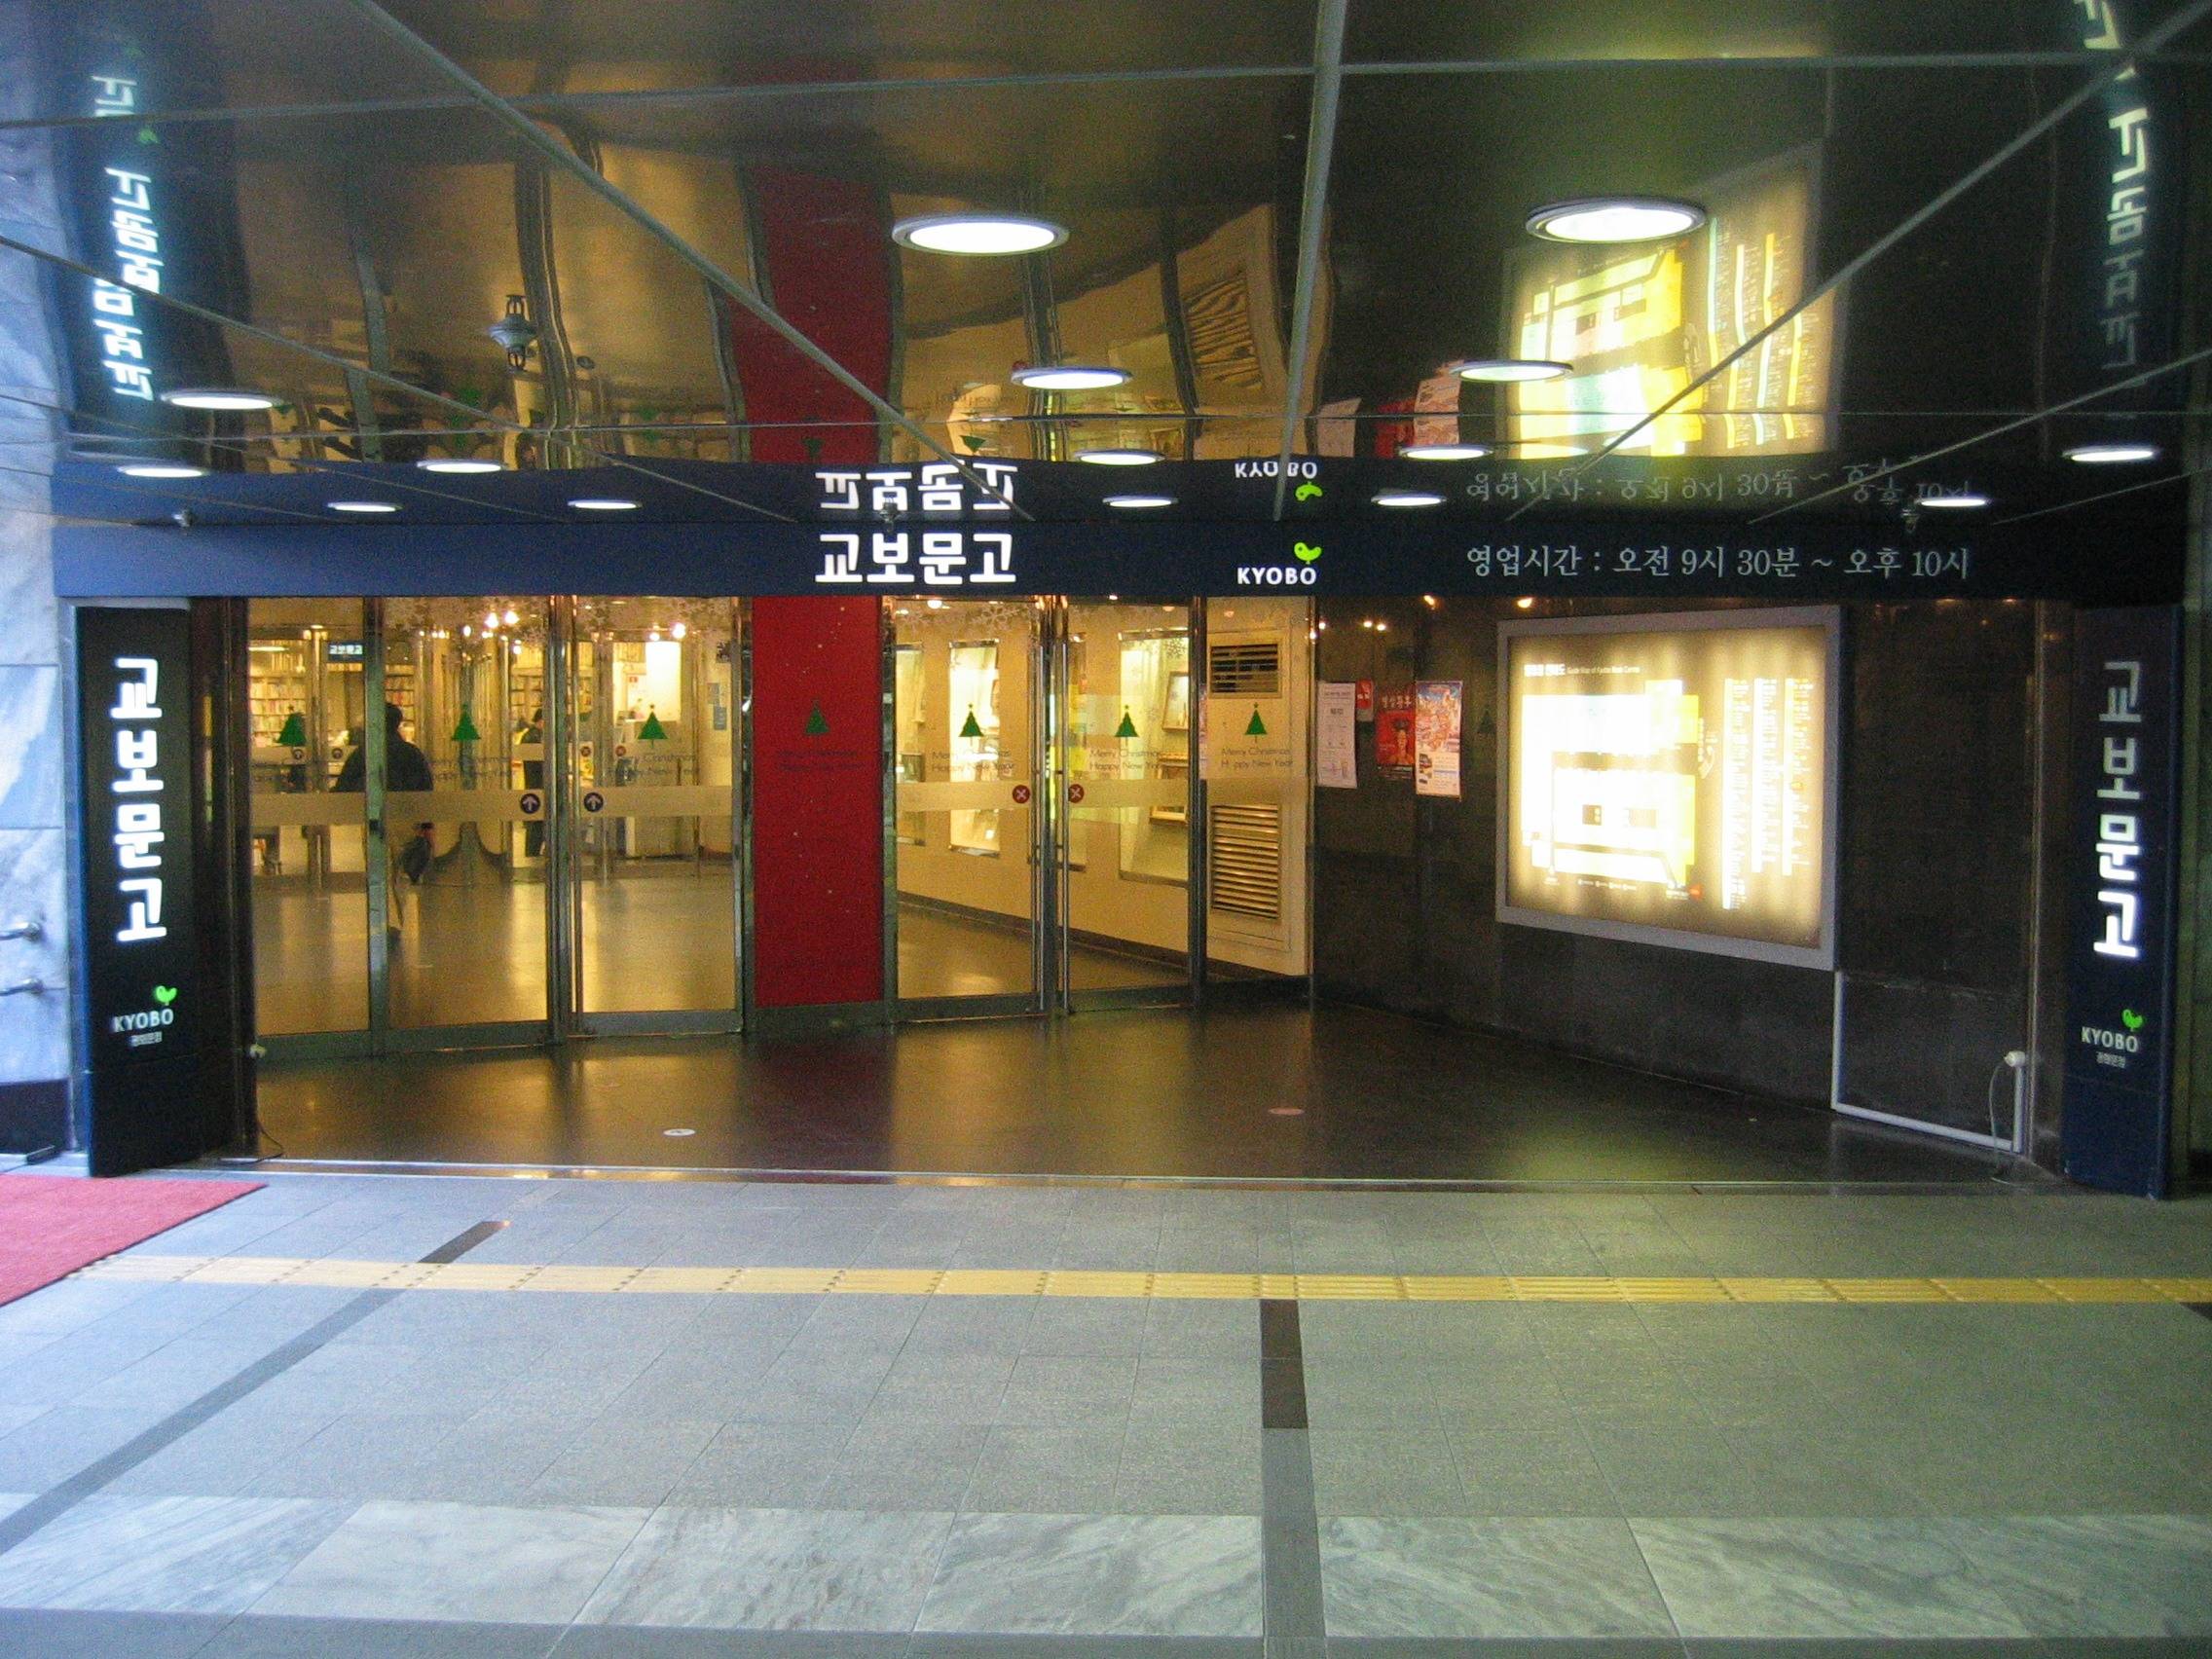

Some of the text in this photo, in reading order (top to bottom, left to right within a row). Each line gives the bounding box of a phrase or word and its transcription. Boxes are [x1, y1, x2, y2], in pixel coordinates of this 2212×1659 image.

[815, 533, 1016, 584] 교보문고
[1466, 545, 1582, 576] 영업시간
[1612, 546, 1670, 576] 오전
[1681, 546, 1724, 577] 9시
[1737, 547, 1800, 577] 30분
[1844, 547, 1901, 579] 오후
[1911, 547, 1968, 579] 10시
[1236, 567, 1316, 585] KYOBO
[110, 657, 167, 941] 교보문고
[2093, 661, 2142, 959] 교보문고
[112, 1008, 174, 1033] KYOBO
[2081, 1026, 2138, 1052] KYOBO
